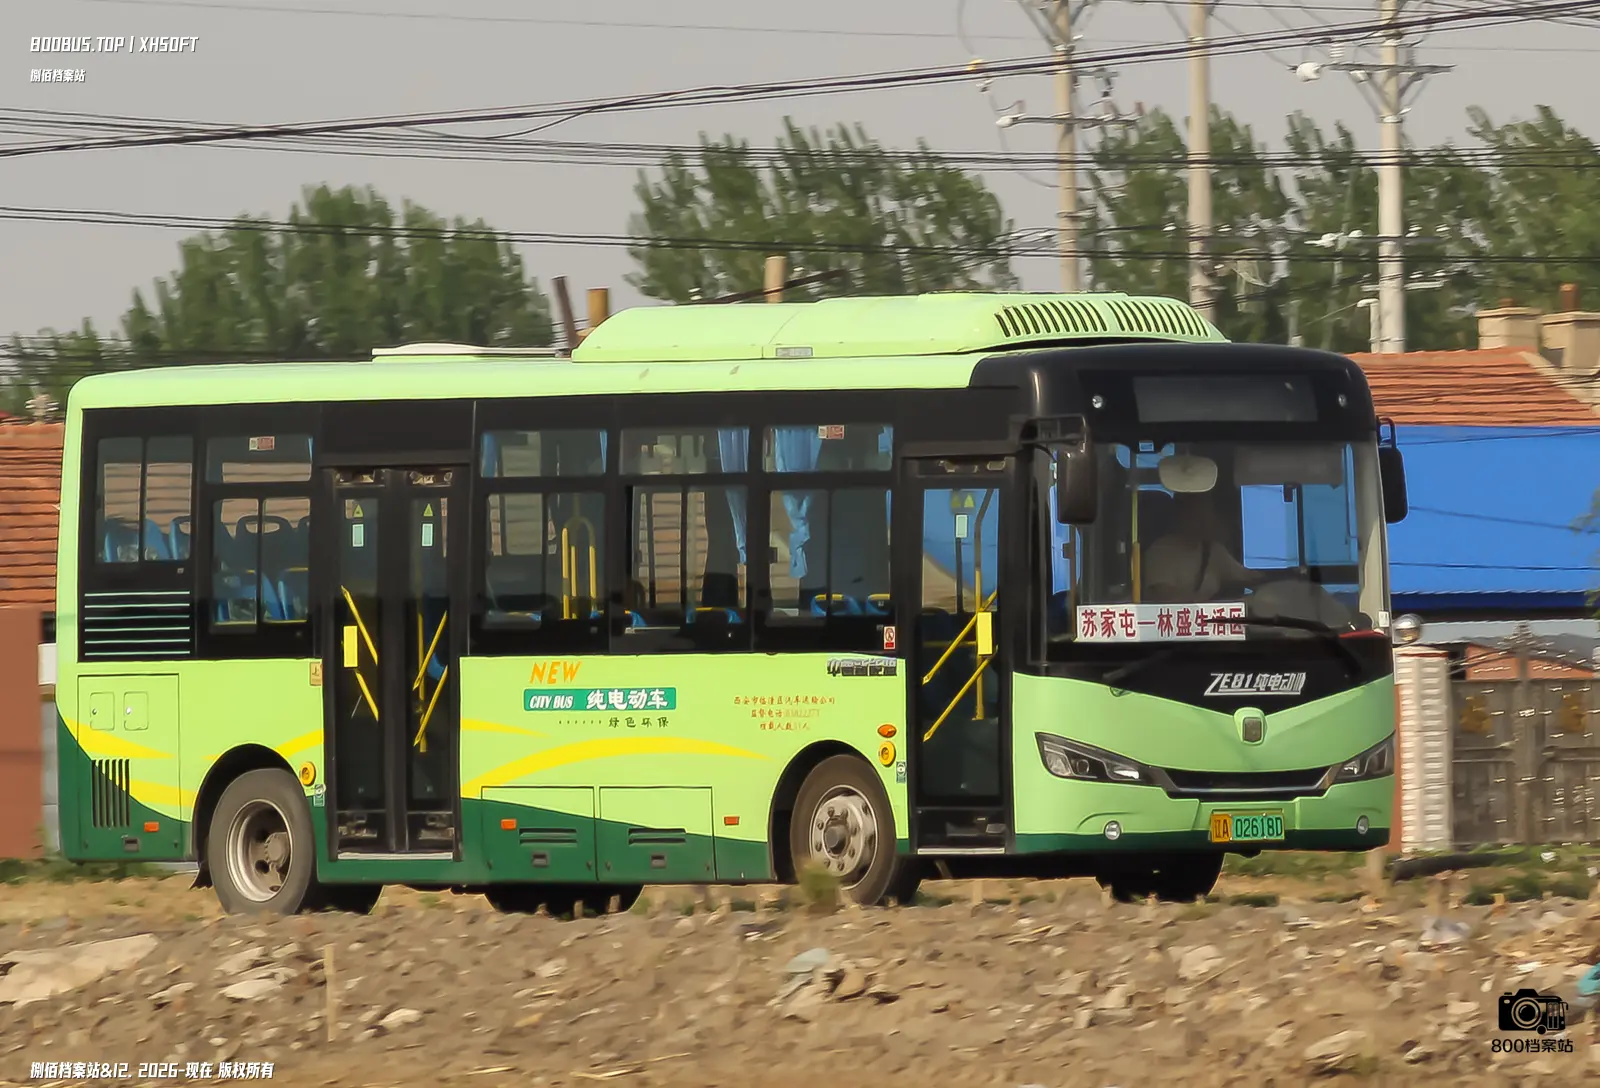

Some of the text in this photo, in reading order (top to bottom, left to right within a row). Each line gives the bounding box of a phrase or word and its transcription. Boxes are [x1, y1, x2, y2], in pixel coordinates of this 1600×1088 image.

[529, 660, 582, 684] NEW
[529, 688, 669, 710] CITY BUS 纯电动车
[608, 716, 670, 728] 绿色环保
